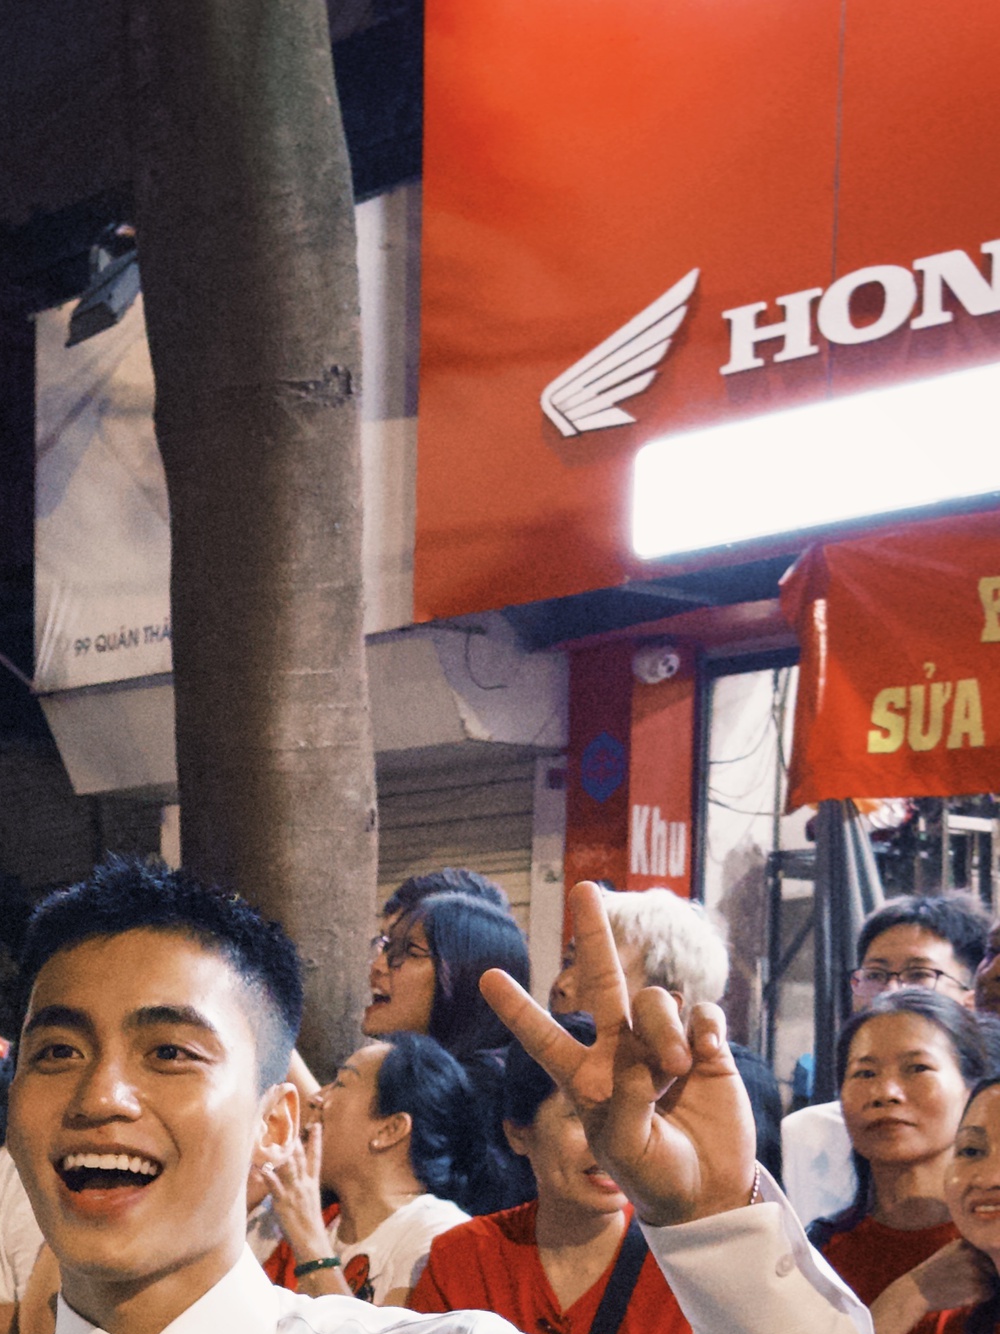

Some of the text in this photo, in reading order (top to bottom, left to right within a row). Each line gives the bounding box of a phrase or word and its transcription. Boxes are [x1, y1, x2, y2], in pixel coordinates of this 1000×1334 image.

[720, 238, 1000, 376] HON
[867, 661, 985, 754] SỬA
[630, 803, 687, 878] Khu
